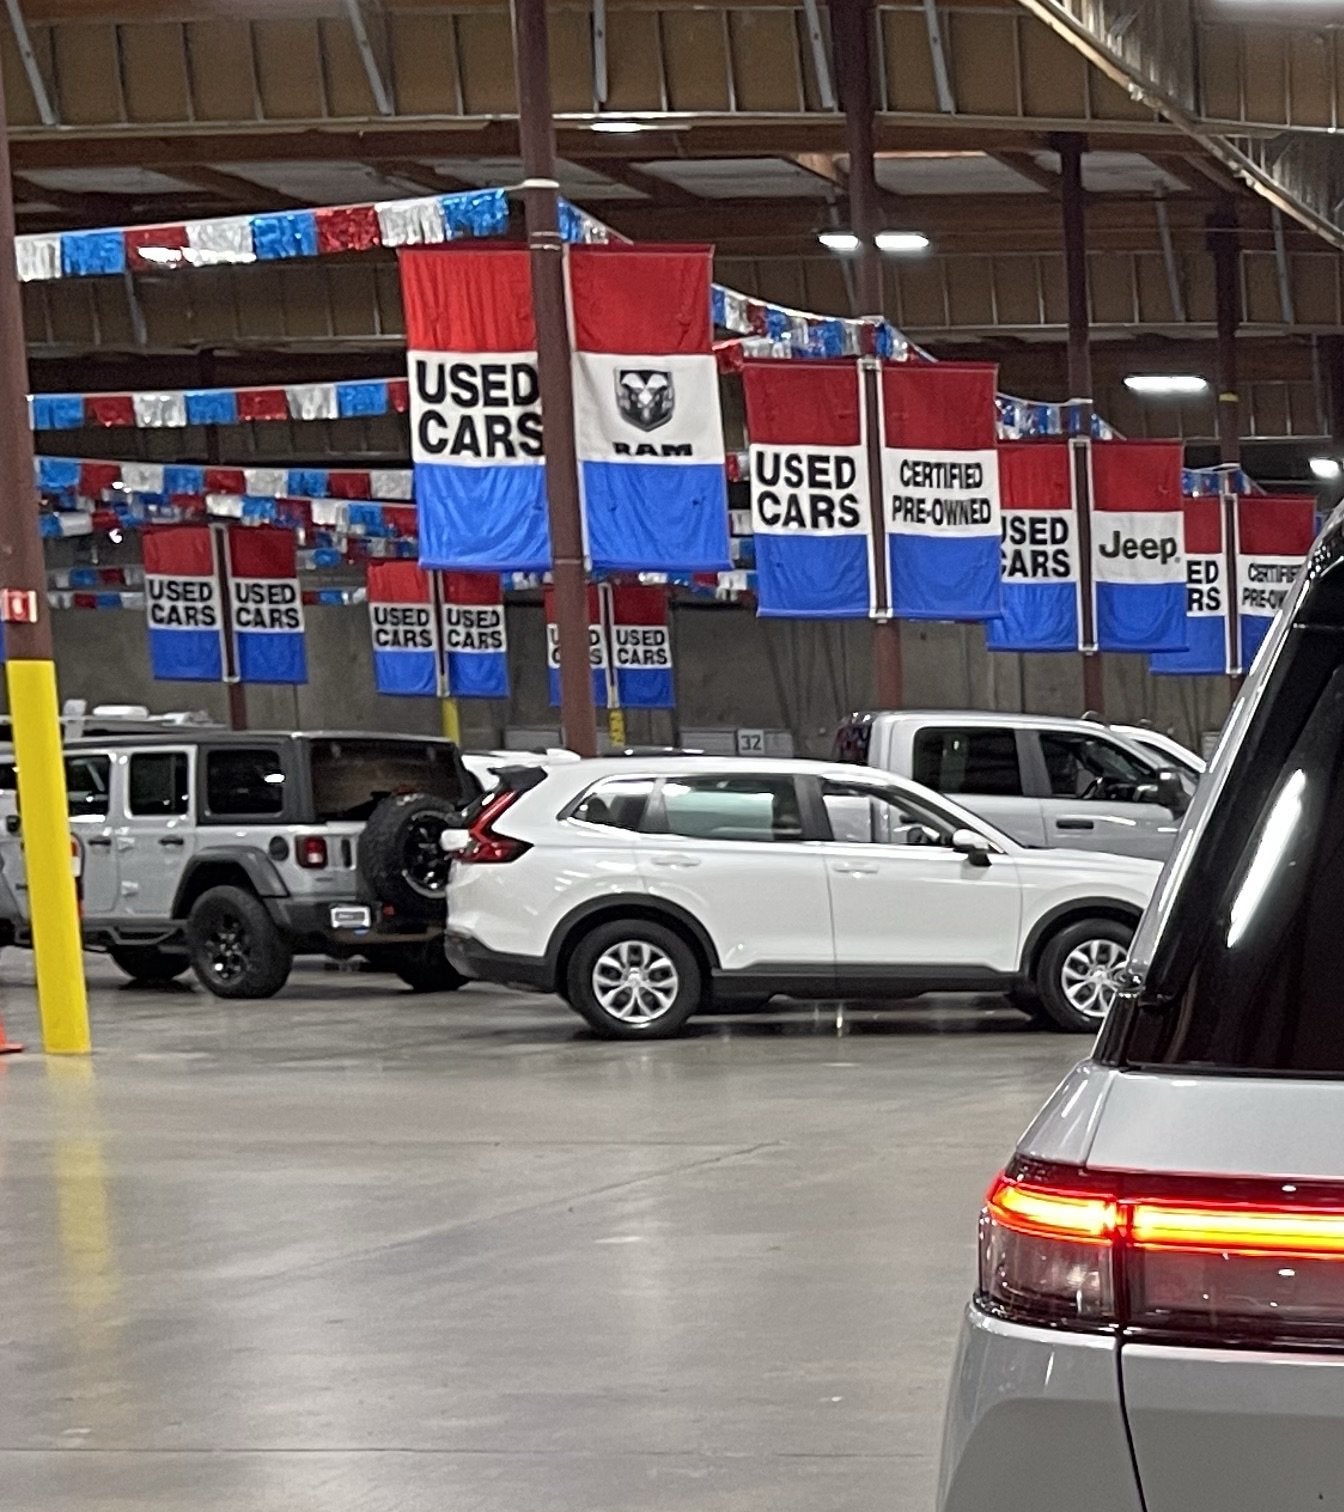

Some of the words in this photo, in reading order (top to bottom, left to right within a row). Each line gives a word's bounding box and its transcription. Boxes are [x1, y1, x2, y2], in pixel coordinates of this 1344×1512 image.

[416, 360, 540, 408] USED
[418, 410, 544, 458] CARS
[612, 442, 693, 457] RAM
[756, 451, 856, 490] USED
[900, 459, 984, 489] CERTIFIED
[757, 490, 861, 529] CARS
[892, 495, 992, 526] PRE-OWNED
[1099, 530, 1177, 565] Jeep
[1186, 560, 1219, 584] ED
[150, 580, 213, 602] USED
[235, 582, 297, 604] USED
[1187, 586, 1221, 612] RS
[151, 603, 217, 627] CARS
[235, 607, 300, 628] CARS
[374, 607, 430, 627] USED
[446, 607, 500, 628] USED
[375, 629, 433, 648] CARS
[447, 629, 503, 649] CARS
[550, 627, 600, 646] UD
[616, 629, 666, 646] USED
[551, 647, 603, 665] CS
[617, 647, 668, 665] CARS
[740, 734, 762, 751] 32
